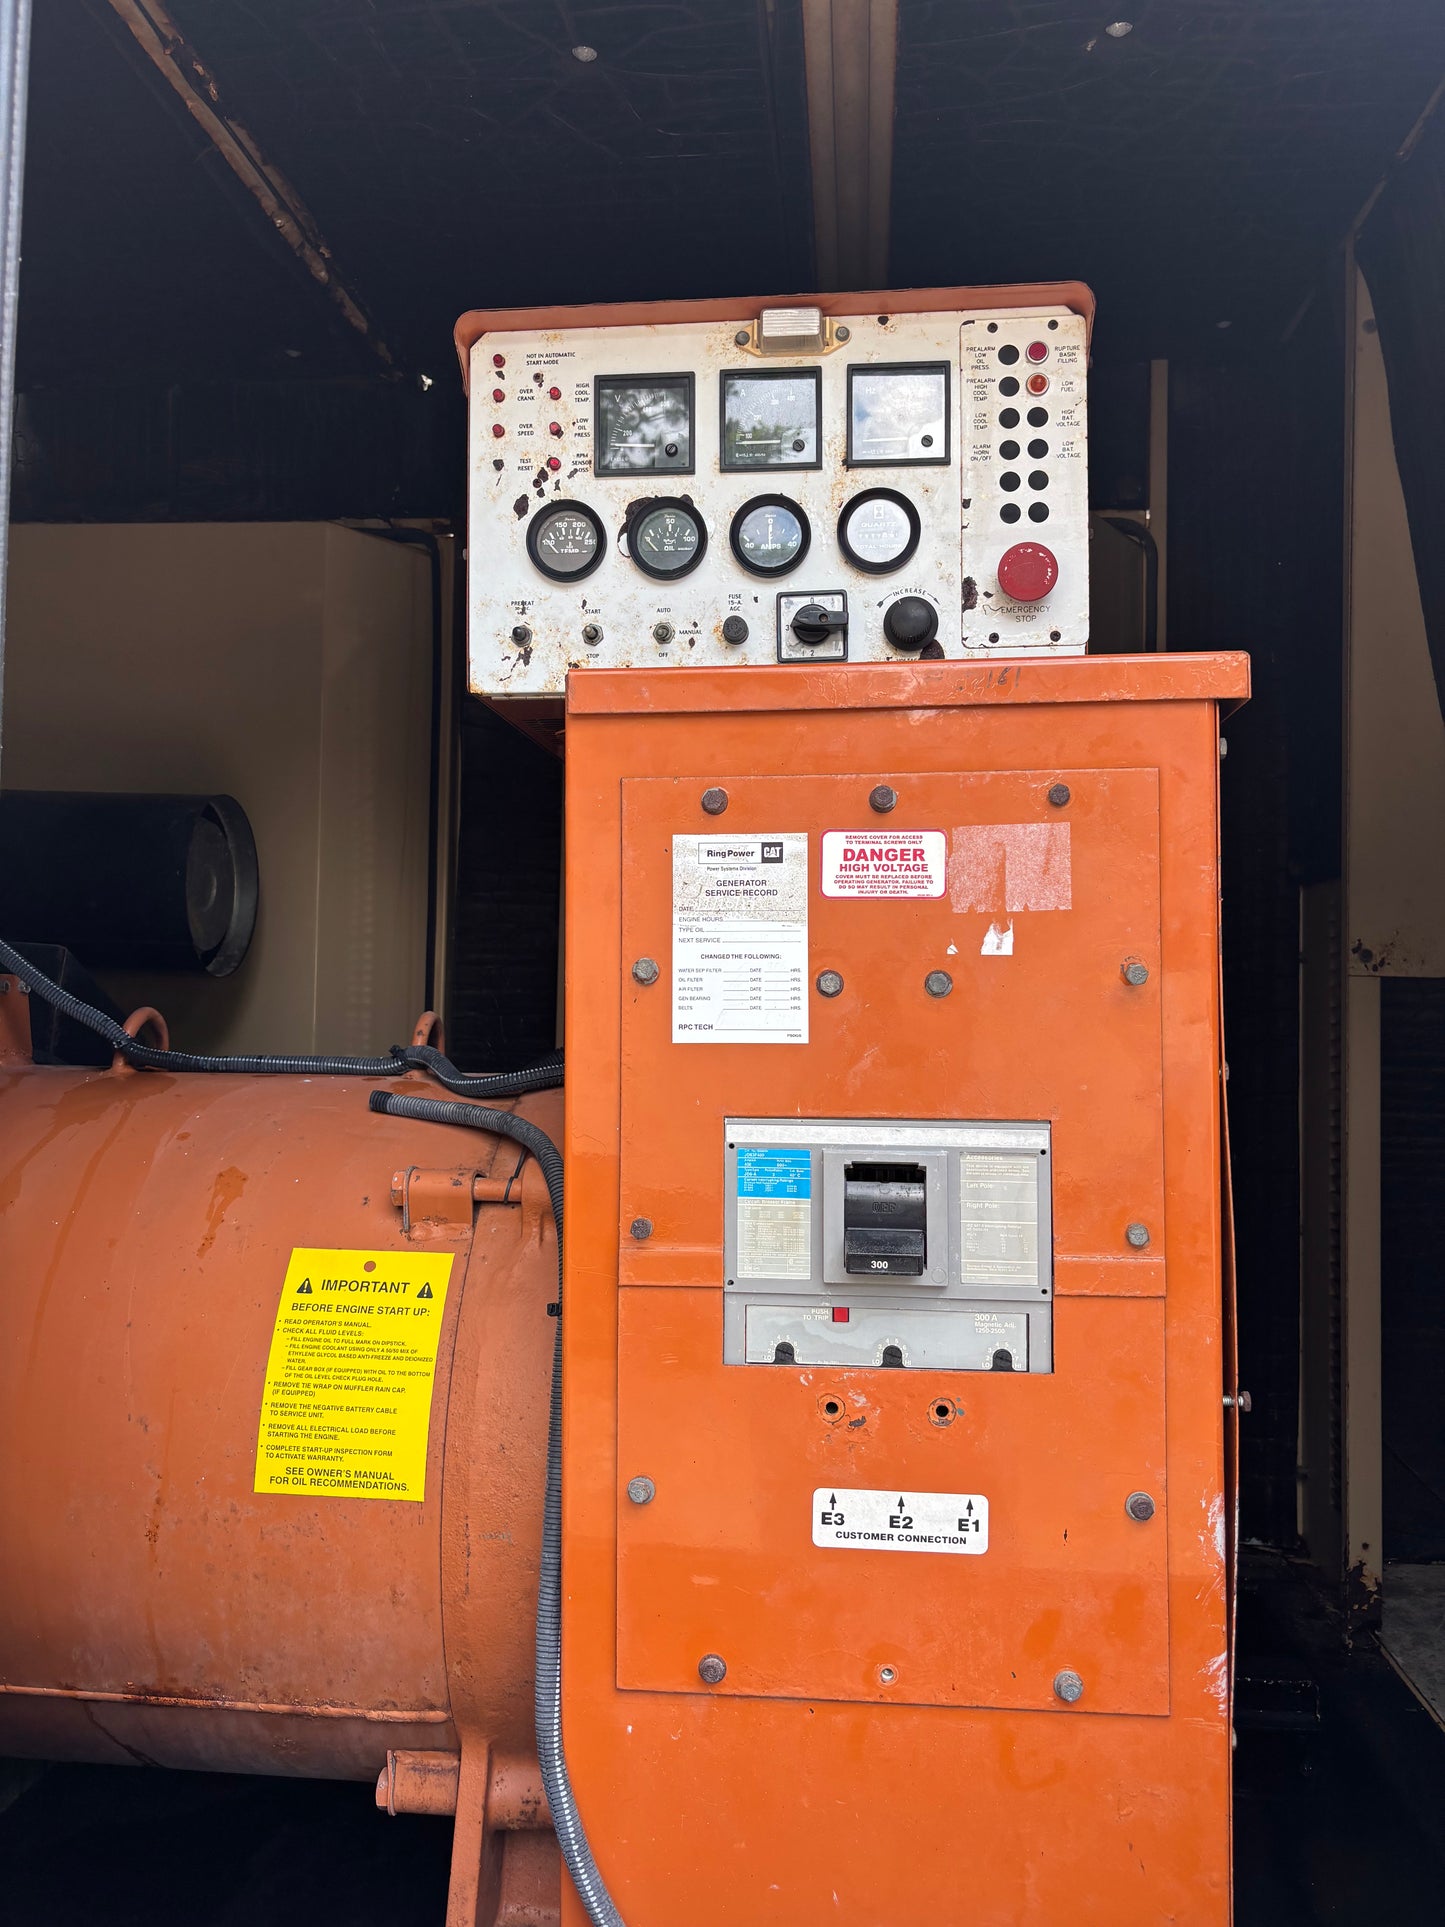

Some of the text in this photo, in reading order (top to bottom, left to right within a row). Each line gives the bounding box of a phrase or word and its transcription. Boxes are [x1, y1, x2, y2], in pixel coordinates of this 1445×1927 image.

[893, 588, 927, 596] INCREASE
[1001, 605, 1051, 614] EMERGENCY
[1015, 615, 1037, 623] STOP
[763, 847, 782, 858] CAT
[843, 848, 925, 862] DANGER
[839, 863, 928, 872] HIGH VOLTAGE
[705, 889, 778, 897] SERVICE RECORD
[870, 1260, 889, 1269] 300
[320, 1279, 410, 1294] IMPORTANT
[291, 1302, 431, 1317] BEFORE ENGINE START UP:
[974, 1313, 998, 1322] 300 A
[974, 1321, 1017, 1330] Magnetic Adj.
[282, 1327, 304, 1335] CHECK
[337, 1329, 365, 1337] LEVELS:
[273, 1381, 300, 1389] REMOVE
[302, 1382, 311, 1390] TIE
[333, 1383, 343, 1391] ON
[344, 1384, 374, 1392] MUFFLER
[375, 1385, 391, 1393] RAIN
[281, 1390, 316, 1398] EQUIPPED)
[270, 1402, 298, 1410] REMOVE
[299, 1403, 312, 1411] THE
[312, 1404, 344, 1412] NEGATIVE
[345, 1405, 374, 1414] BATTERY
[279, 1410, 307, 1418] SERVICE
[308, 1411, 325, 1419] UNIT.
[268, 1423, 295, 1431] REMOVE
[296, 1424, 308, 1432] ALL
[309, 1425, 349, 1433] ELECTRICAL
[369, 1427, 396, 1435] BEFORE
[267, 1431, 299, 1439] STARTING
[266, 1444, 393, 1457] COMPLETE START-UP INSPECTION FORM
[275, 1453, 306, 1461] ACTIVATE
[307, 1454, 345, 1462] WARRANTY.
[285, 1467, 392, 1481] SEE OWNER'S MANUAL
[269, 1475, 410, 1492] FOR OIL RECOMMENDATIONS.
[821, 1512, 980, 1533] E3 E2 E1
[835, 1531, 967, 1544] CUSTOMER CONNECTION
